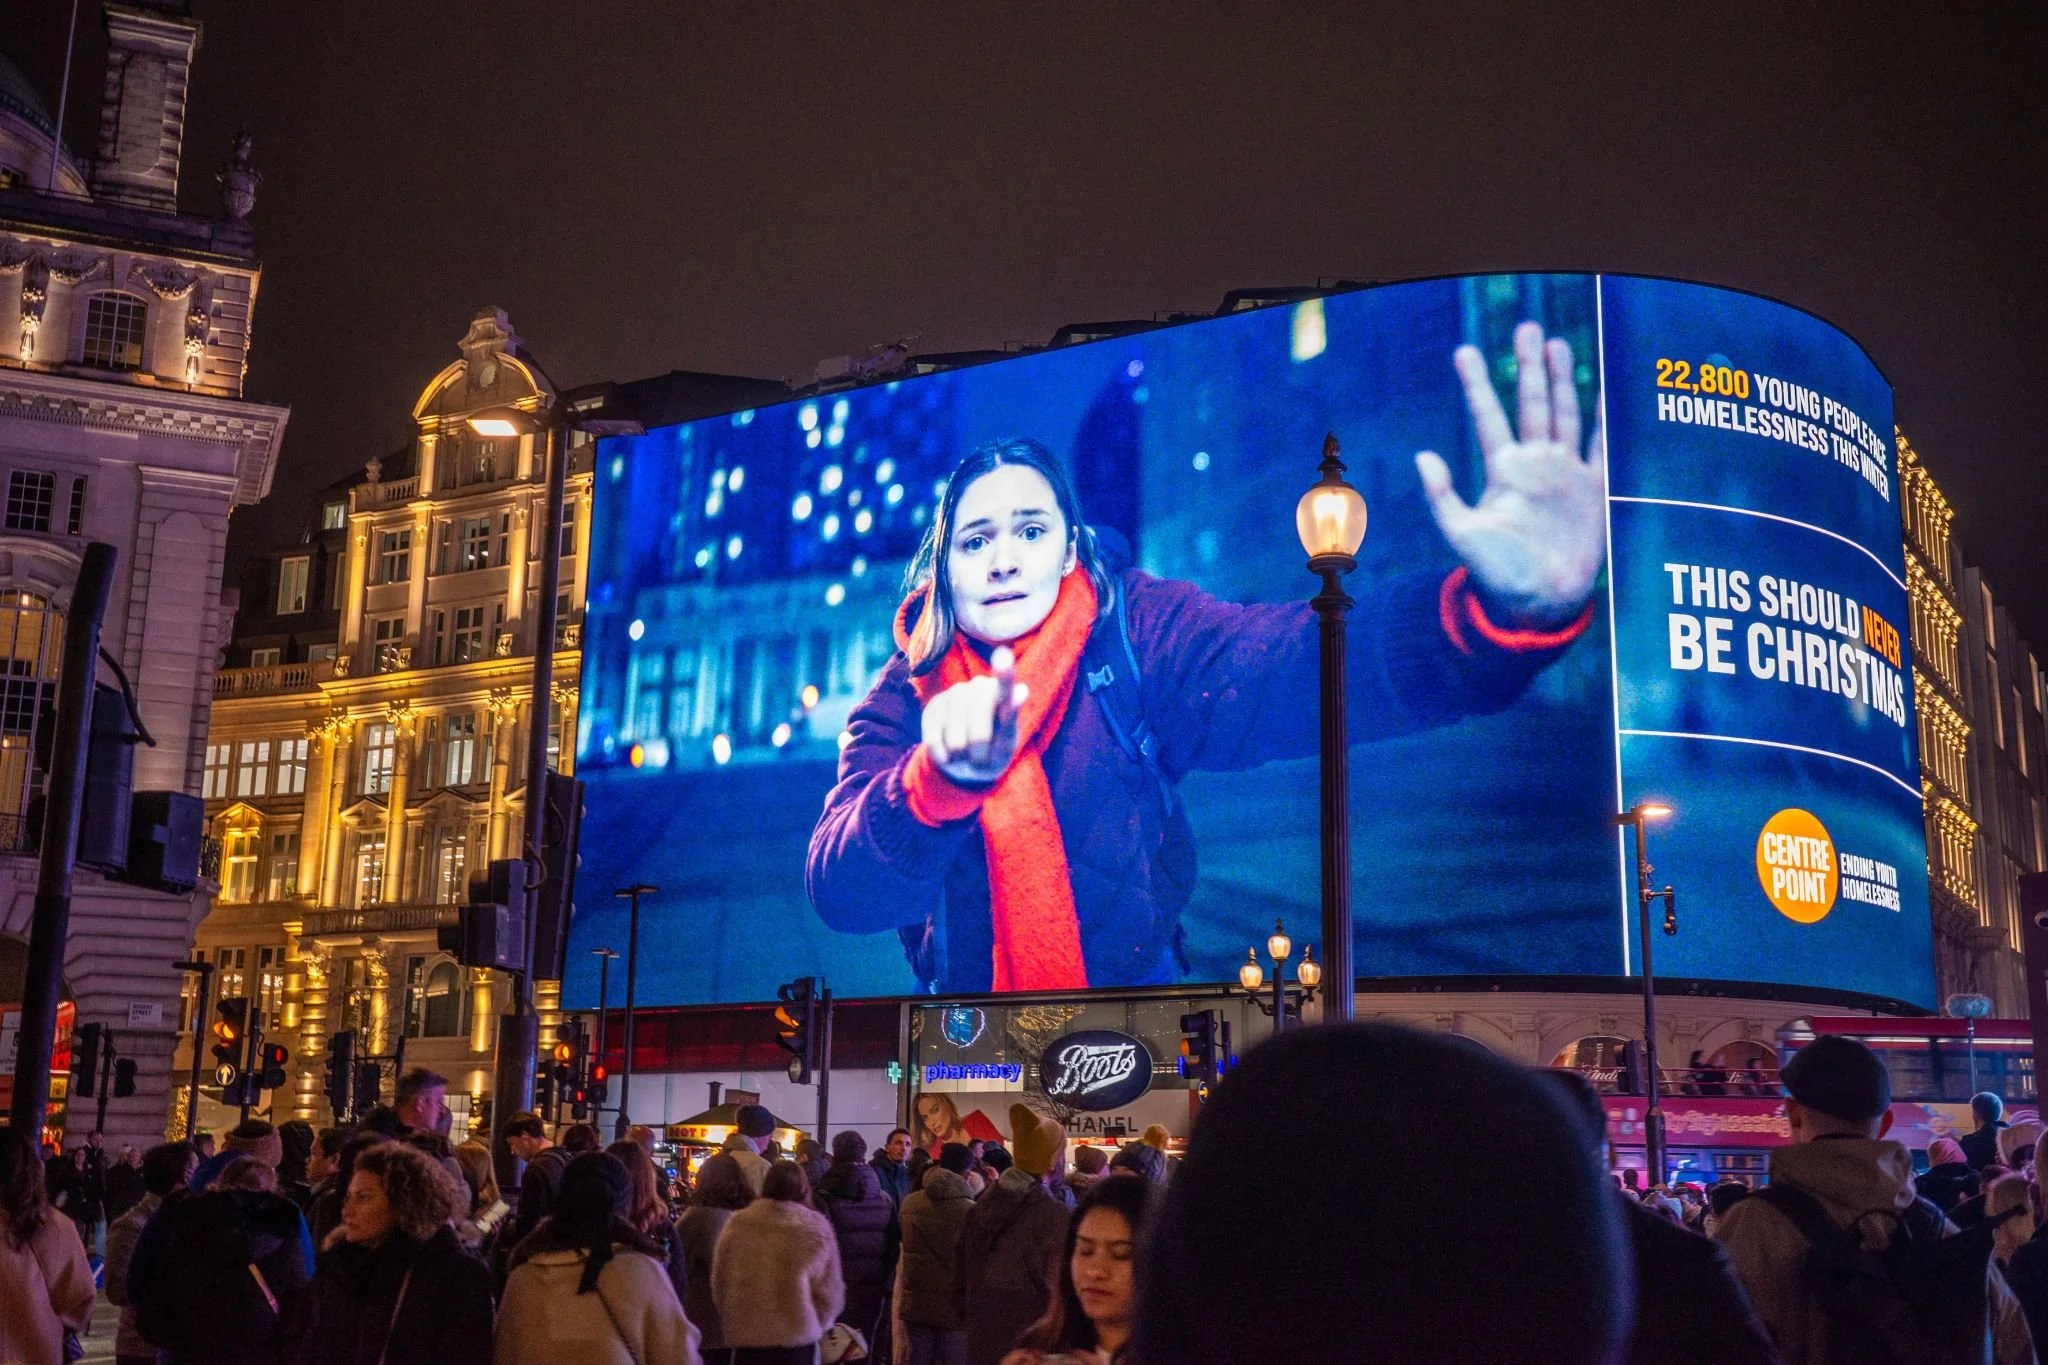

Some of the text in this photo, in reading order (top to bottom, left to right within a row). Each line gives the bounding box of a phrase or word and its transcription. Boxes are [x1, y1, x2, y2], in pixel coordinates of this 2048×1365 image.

[1656, 358, 1888, 472] 22,800 YOUNG PEOPLE FACE
[1657, 393, 1890, 503] HOMELESSNESS THIS WINTER
[1663, 562, 1903, 670] THIS SHOULD NEVER
[1668, 612, 1906, 728] BE CHRISTMAS
[1763, 831, 1831, 872] CENTRE
[1840, 852, 1899, 889] ENDING YOUTH
[1772, 866, 1827, 905] POINT
[1842, 877, 1901, 913] HOMELESSNESS
[925, 1059, 1023, 1083] pharmacy
[1048, 1043, 1136, 1095] Boots
[1068, 1116, 1139, 1133] HANEL
